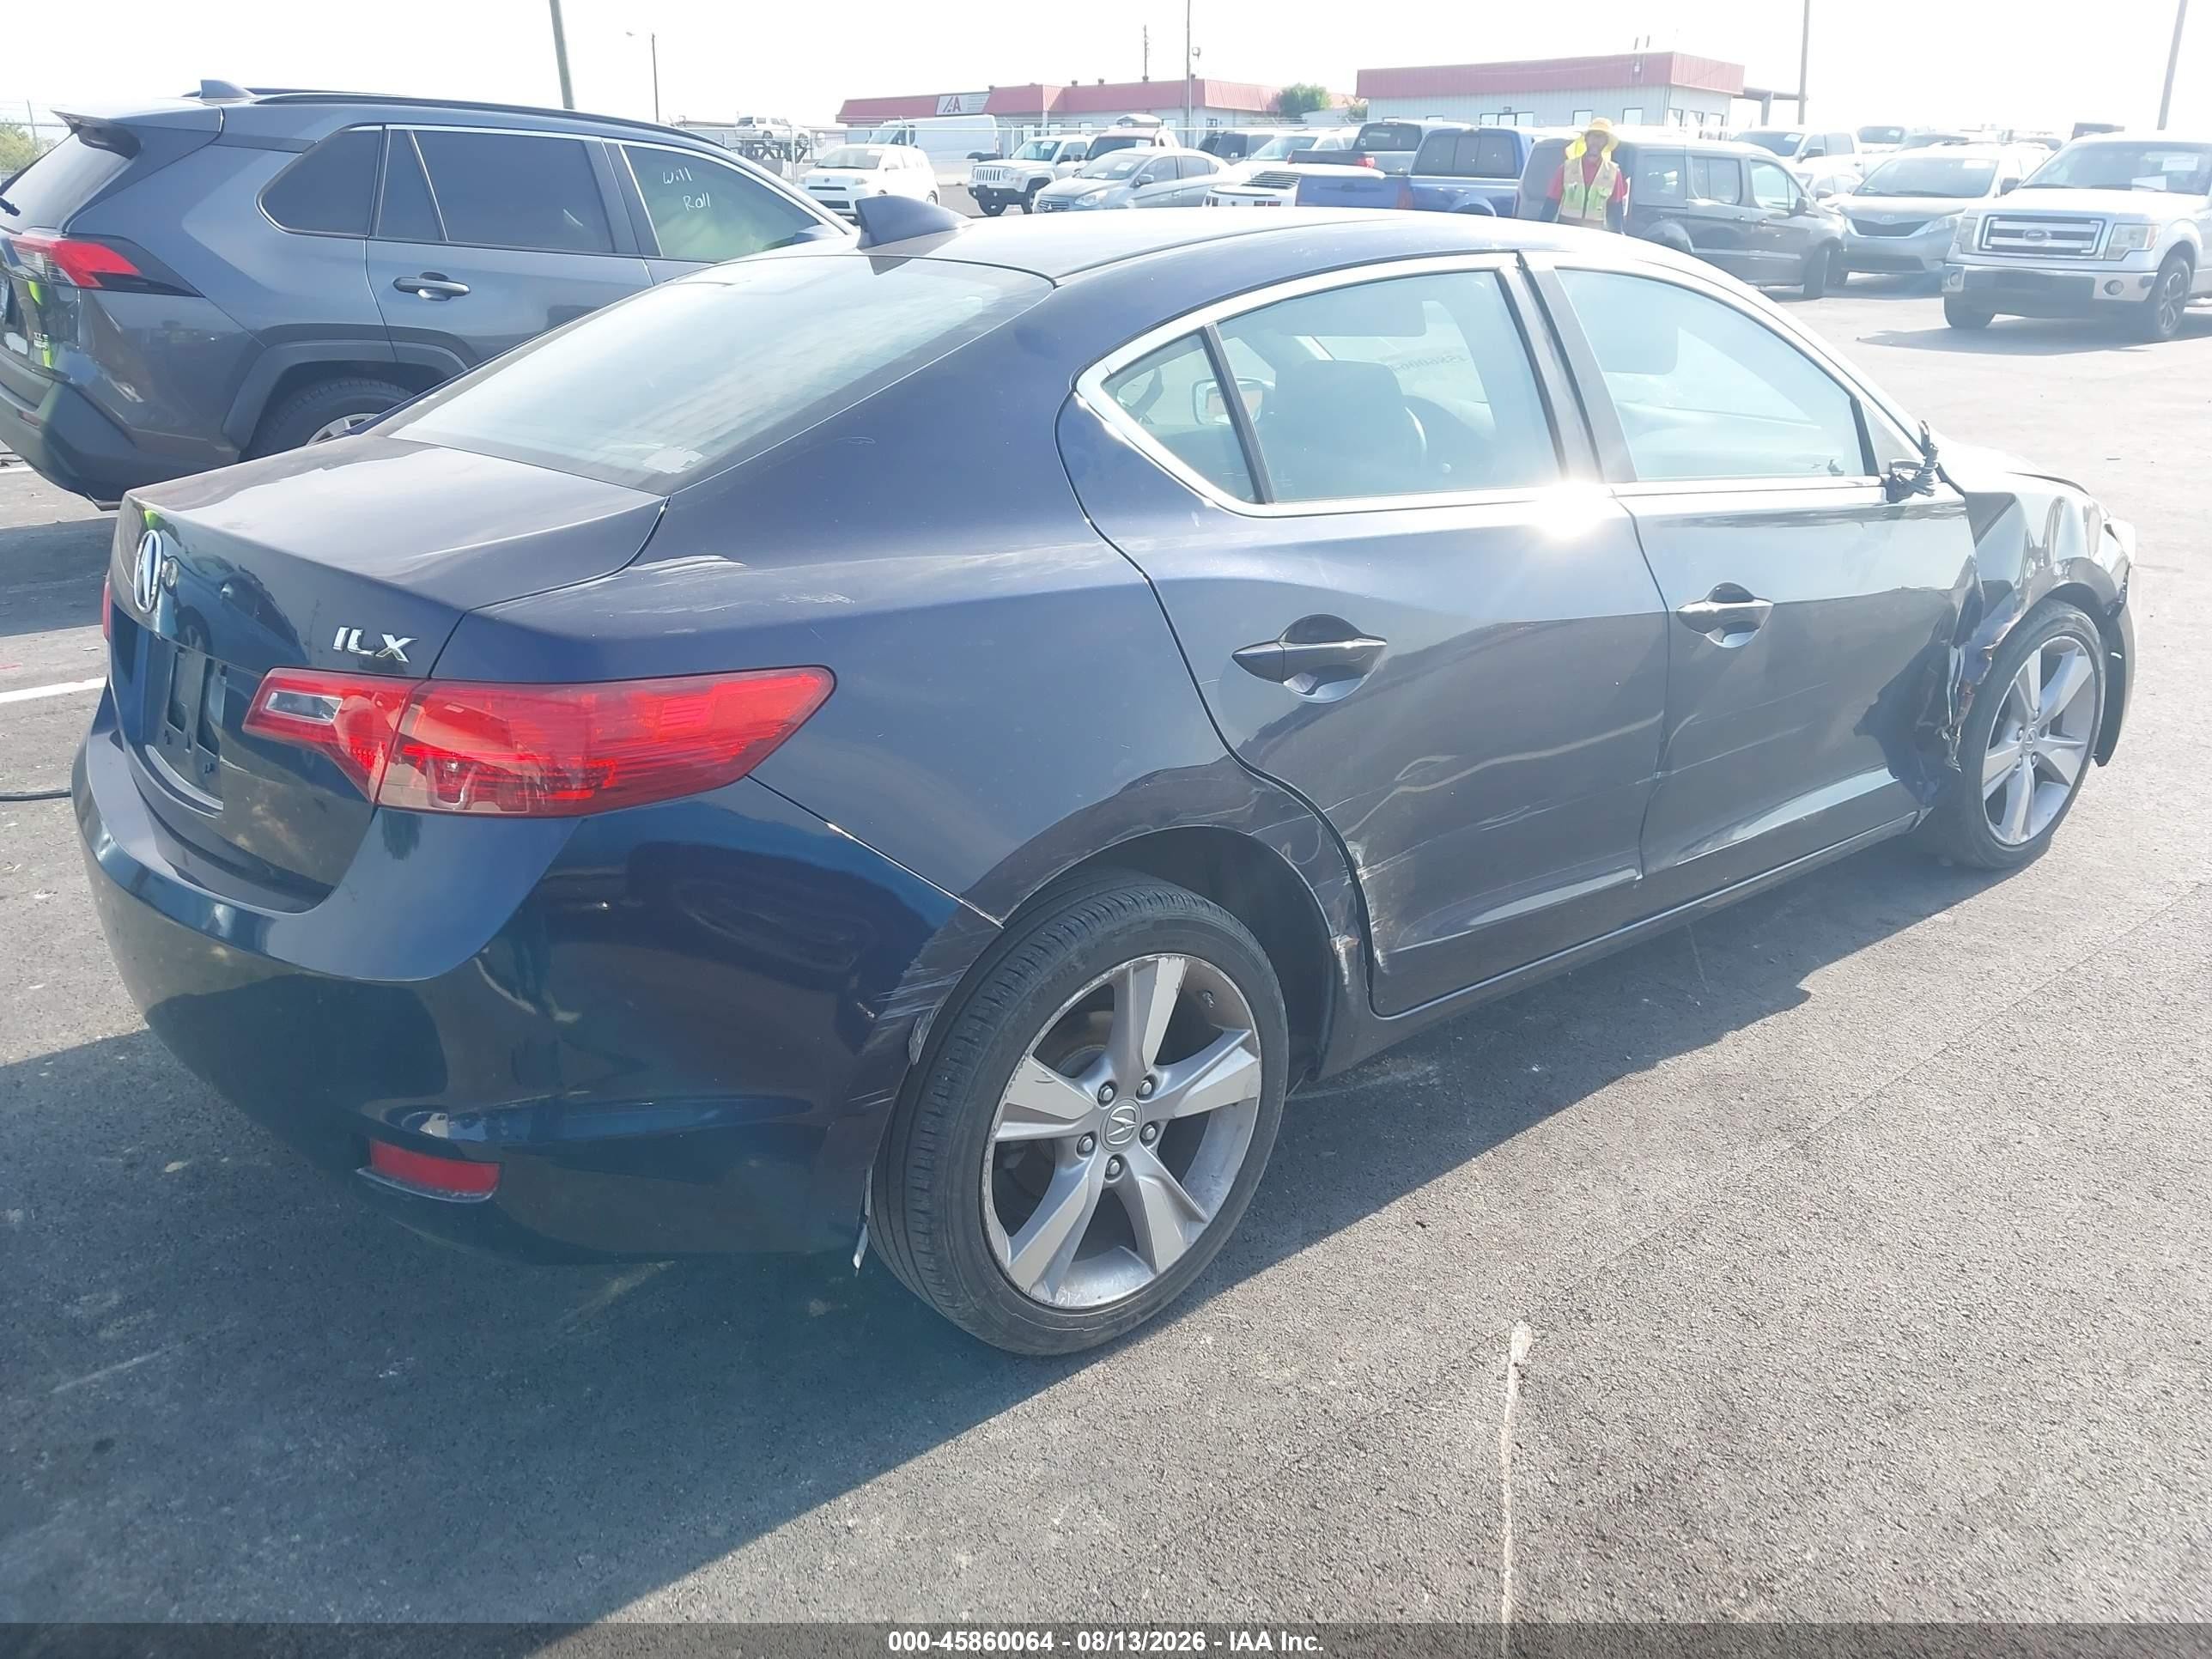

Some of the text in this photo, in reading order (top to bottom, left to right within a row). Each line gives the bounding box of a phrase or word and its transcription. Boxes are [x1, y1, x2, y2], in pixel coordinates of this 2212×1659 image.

[662, 167, 693, 184] Will
[683, 192, 711, 210] Roll
[332, 627, 418, 663] ILX
